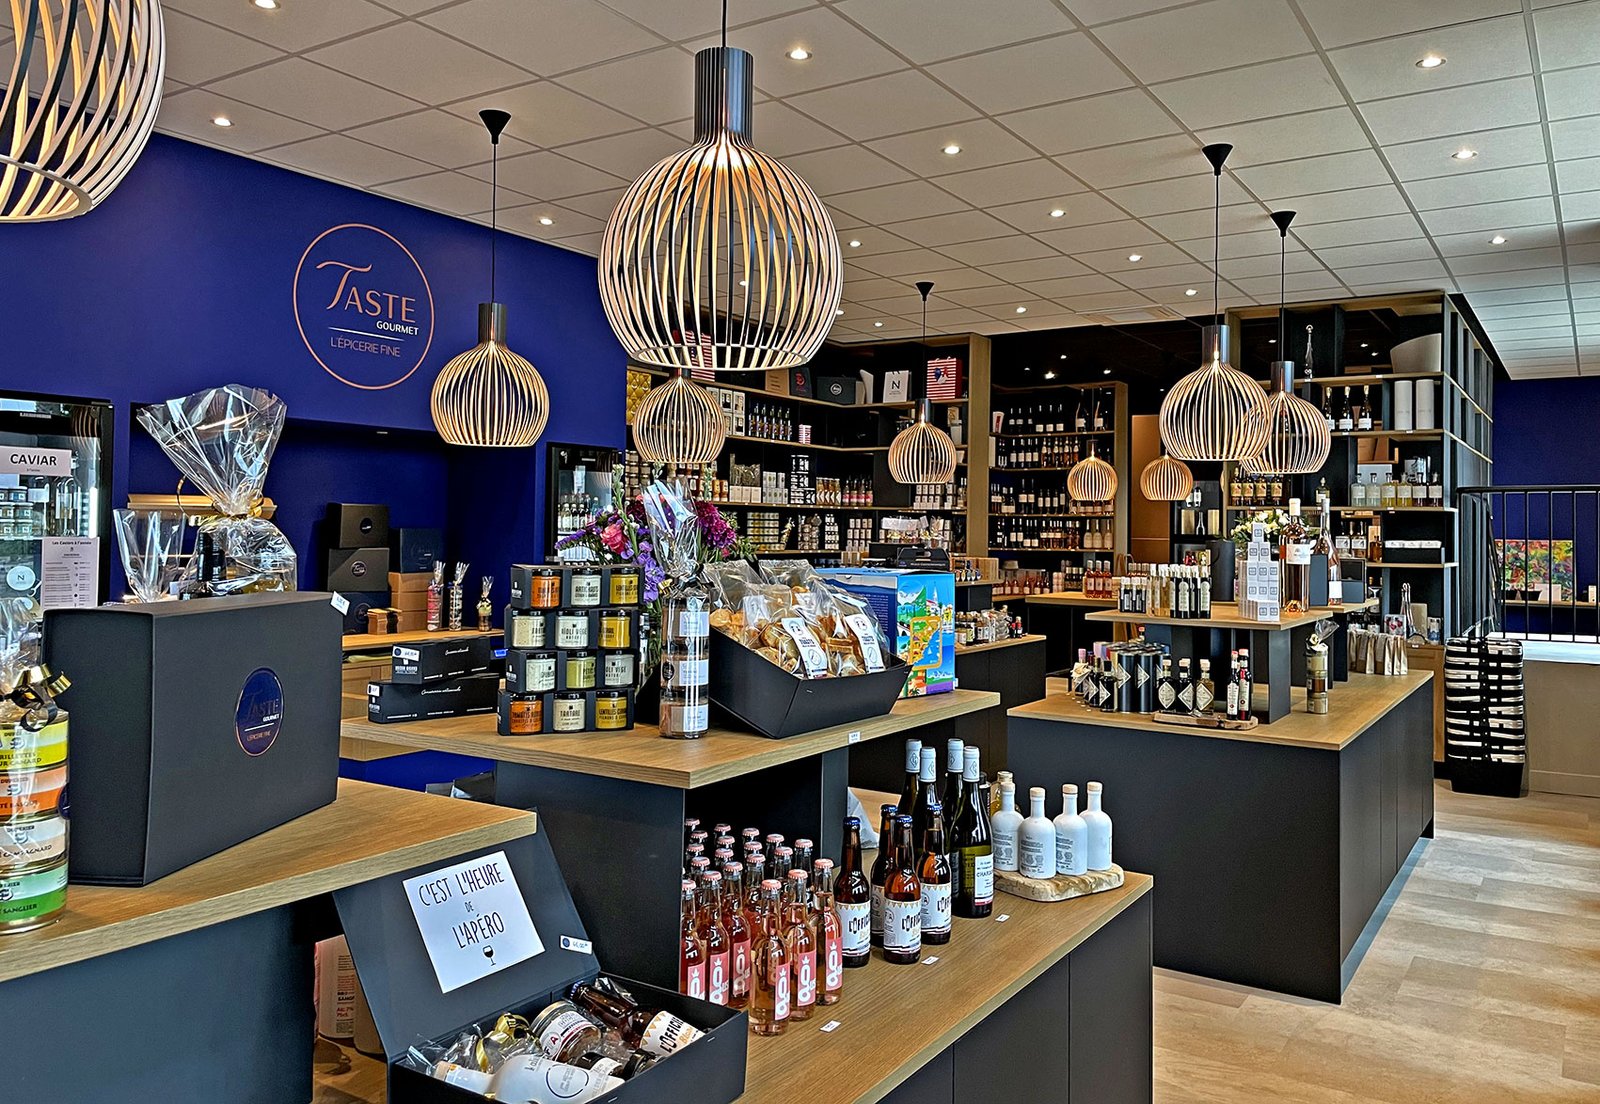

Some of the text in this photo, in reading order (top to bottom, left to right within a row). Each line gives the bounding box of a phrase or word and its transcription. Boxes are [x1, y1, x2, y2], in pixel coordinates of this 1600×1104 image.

[316, 261, 416, 323] TASTE
[376, 320, 419, 336] GOURMET
[380, 345, 401, 358] FINE
[891, 381, 900, 389] N
[10, 453, 57, 466] CAVIAR
[418, 862, 505, 907] C'EST L'HEURE
[3, 902, 38, 914] SANGLIER
[464, 901, 474, 913] DE
[452, 911, 505, 949] L'APÉRO
